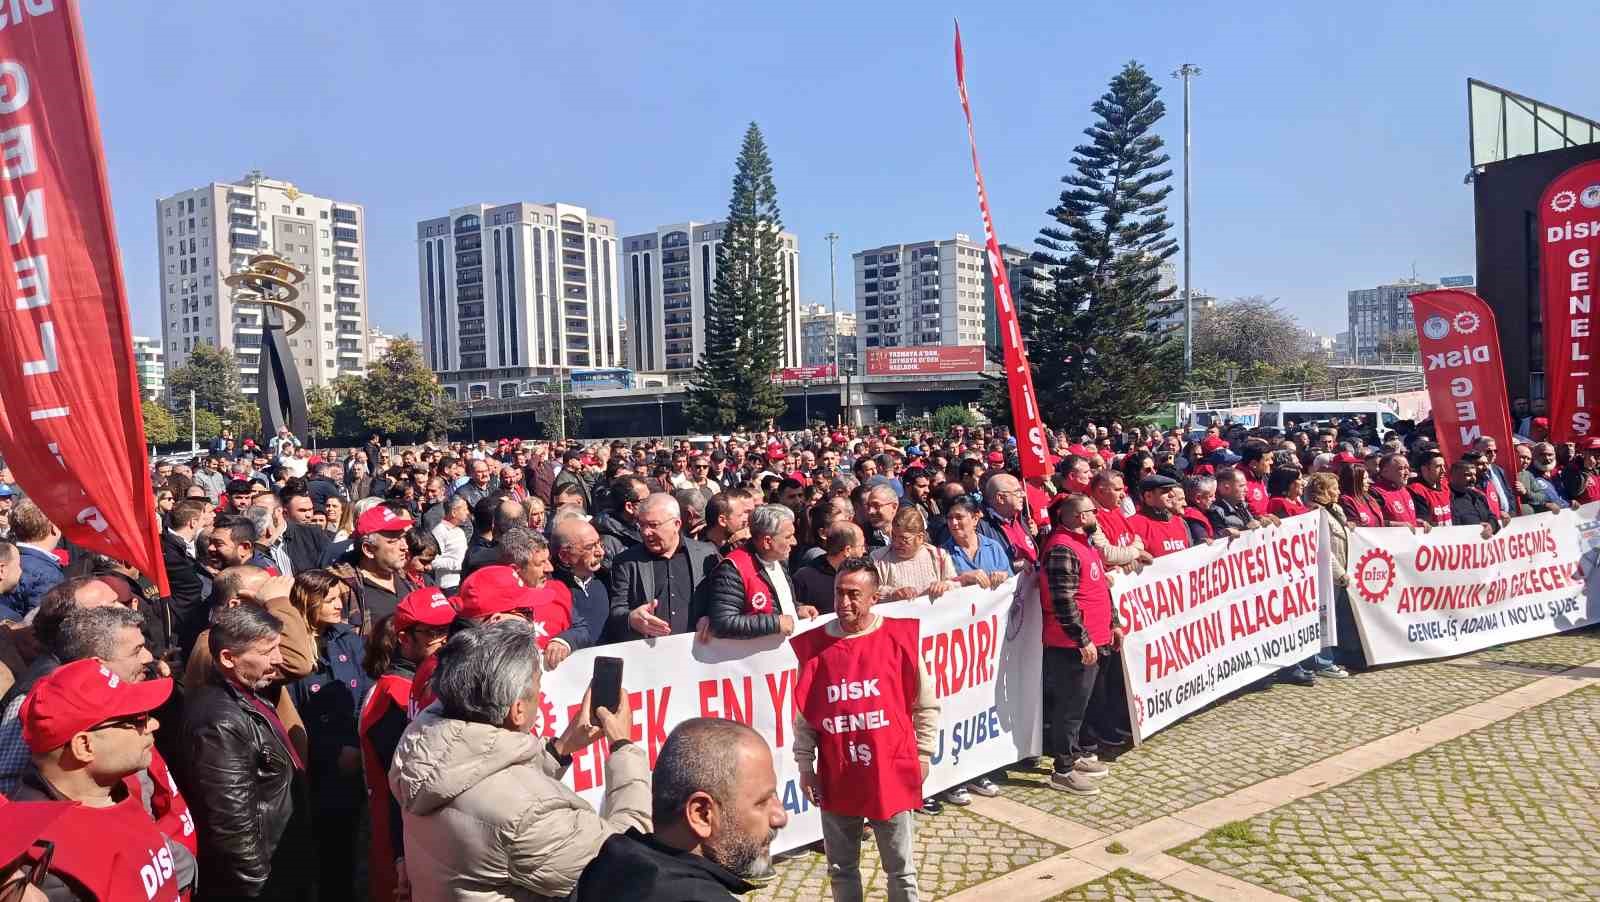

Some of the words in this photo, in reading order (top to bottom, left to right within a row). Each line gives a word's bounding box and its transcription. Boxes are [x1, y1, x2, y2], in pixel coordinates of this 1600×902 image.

[1415, 542, 1489, 572] ONURLU
[1508, 522, 1558, 563] GEÇMİŞ
[1364, 567, 1388, 581] DİSK
[1397, 582, 1486, 614] AYDINLIK
[1486, 571, 1507, 605] BİR
[1118, 574, 1185, 636] SEYHAN
[1407, 614, 1459, 642] GENEL-İŞ
[1460, 613, 1498, 635] ADANA
[1144, 610, 1226, 683] HAKKINI
[1229, 575, 1318, 642] ALACAK!
[827, 678, 881, 703] DİSK
[1147, 687, 1173, 718] DİSK
[1175, 664, 1216, 704] GENEL-İŞ
[1216, 653, 1253, 681] ADANA
[823, 709, 890, 734] GENEL
[951, 704, 1000, 766] ŞUBE
[849, 741, 872, 767] İŞ
[140, 848, 176, 901] DİS
